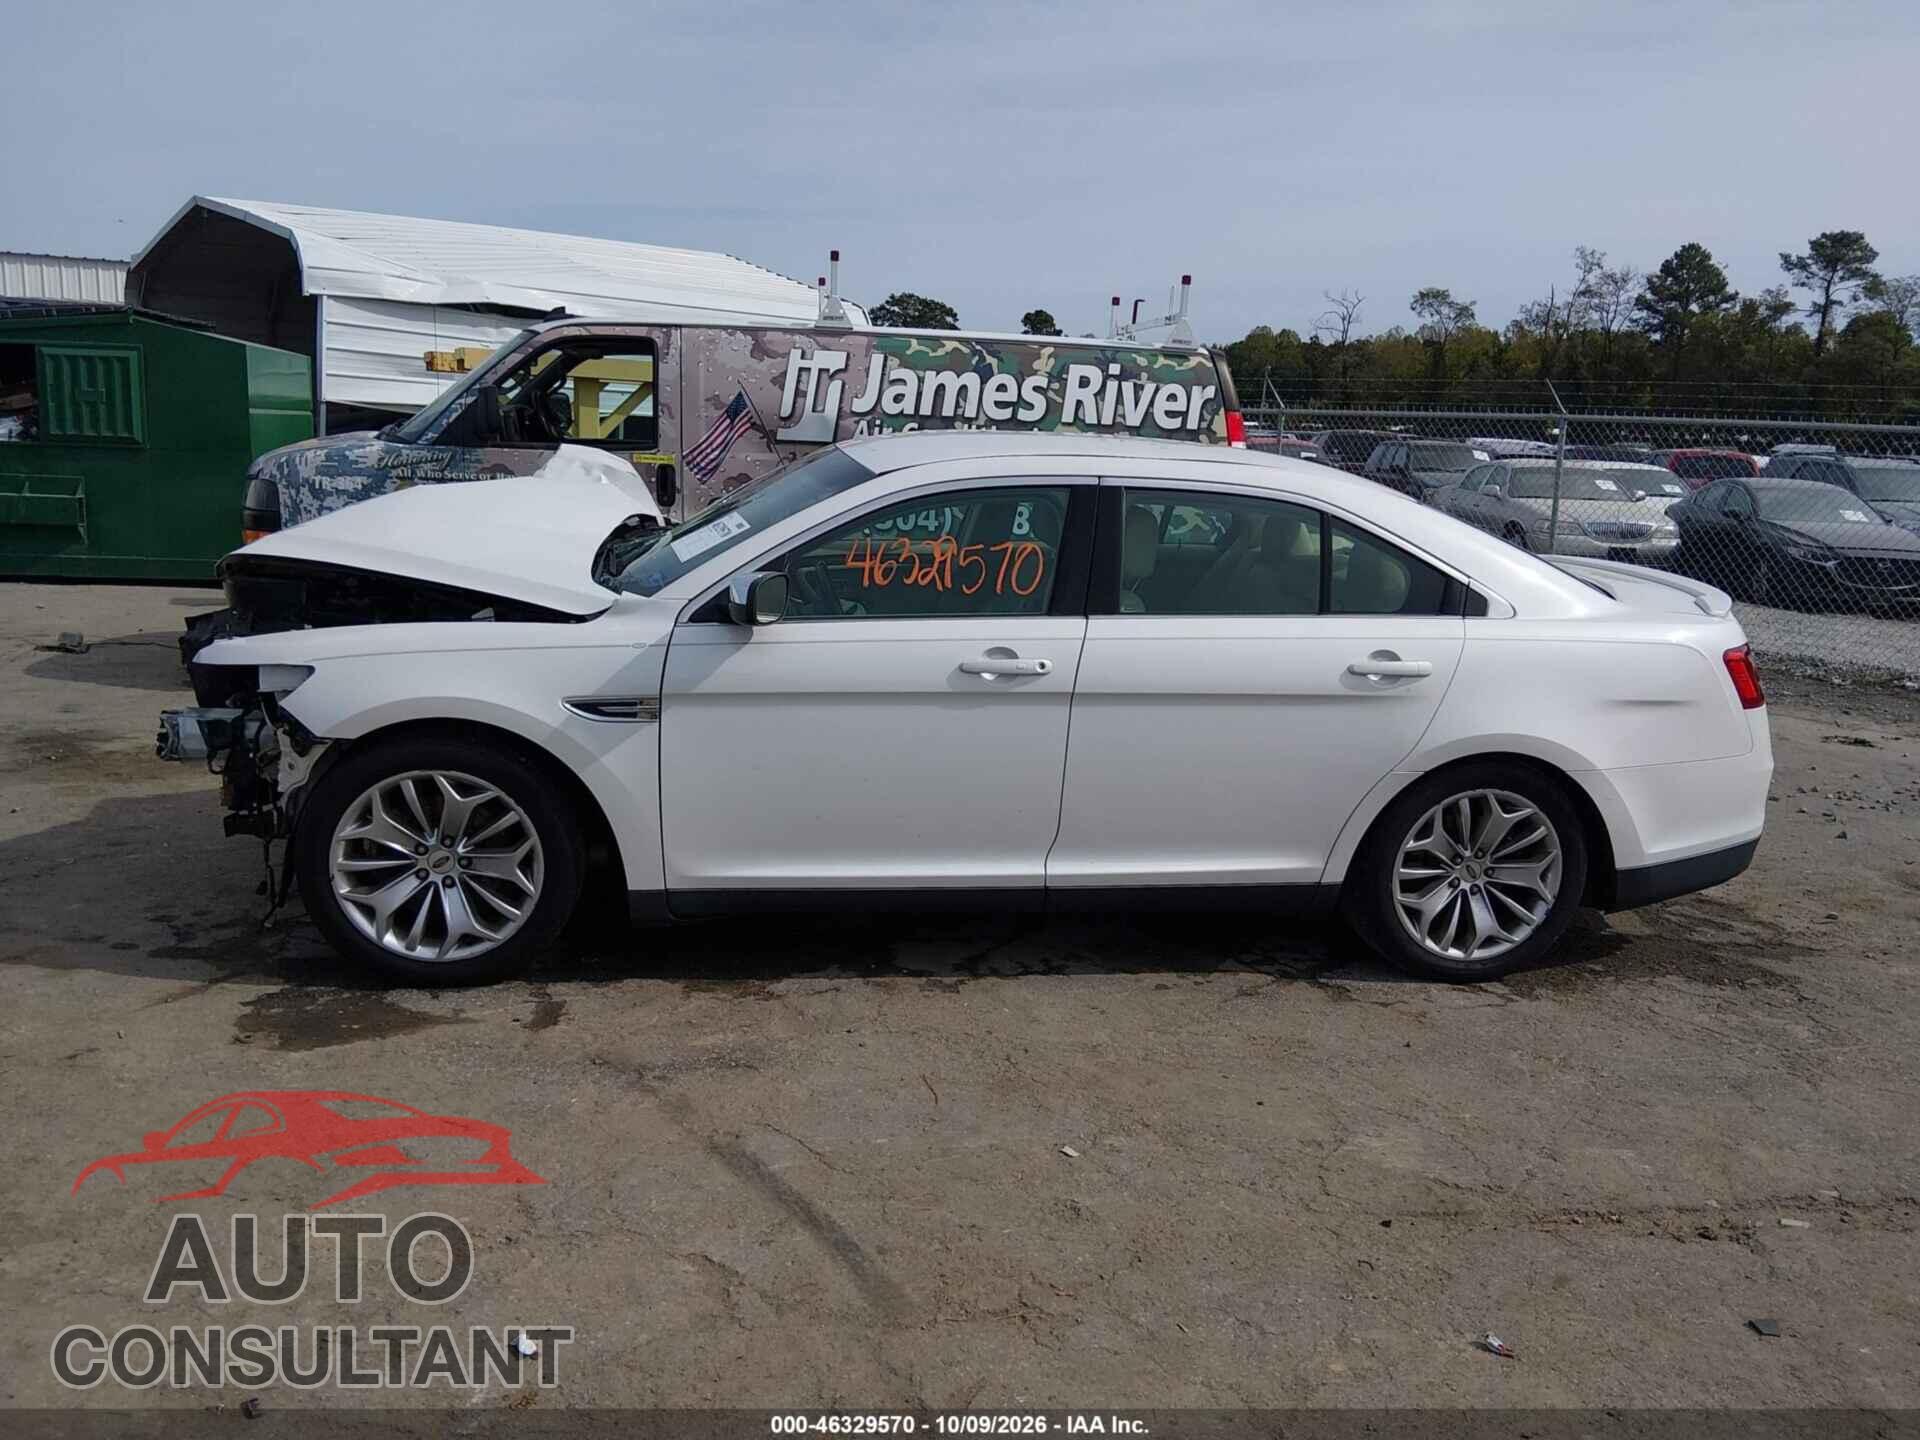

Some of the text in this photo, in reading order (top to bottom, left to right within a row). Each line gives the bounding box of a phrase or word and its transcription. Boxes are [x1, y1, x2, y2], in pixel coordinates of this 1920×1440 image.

[852, 352, 1048, 423] James
[1062, 363, 1216, 431] River
[416, 468, 442, 479] Who
[443, 469, 477, 480] Serve
[847, 535, 1044, 595] 46329570
